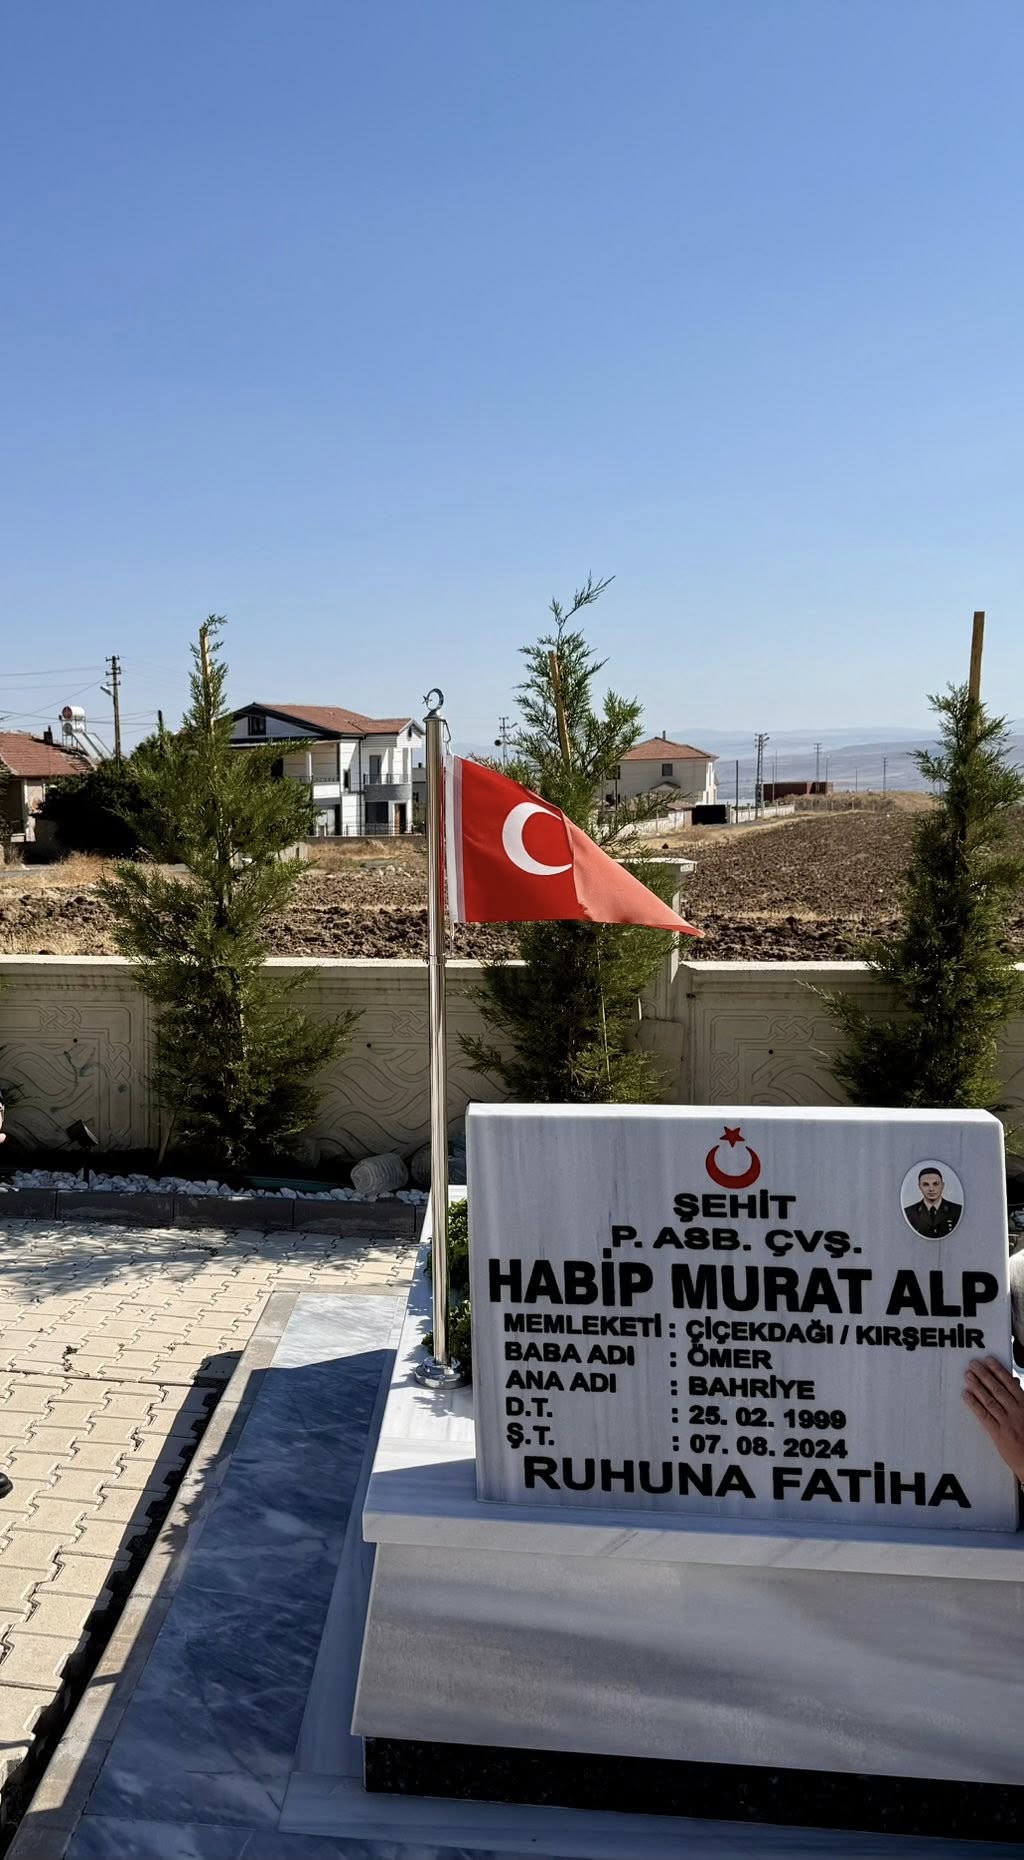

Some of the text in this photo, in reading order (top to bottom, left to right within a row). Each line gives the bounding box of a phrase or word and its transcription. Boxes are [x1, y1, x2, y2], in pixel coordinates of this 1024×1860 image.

[673, 1188, 797, 1223] ŞEHİT
[612, 1224, 862, 1259] P. ASB. ÇVŞ.
[488, 1247, 999, 1318] HABİP MURAT ALP
[503, 1312, 662, 1339] MEMLEKETİ
[685, 1315, 834, 1345] ÇİÇEKDAĞI
[855, 1322, 986, 1352] KIRŞEHİR
[504, 1341, 583, 1364] BABA
[586, 1343, 636, 1367] ADI
[687, 1342, 774, 1370] ÖMER
[505, 1369, 565, 1392] ANA
[569, 1371, 617, 1394] ADI
[688, 1374, 816, 1401] BAHRİYE
[505, 1396, 553, 1418] D.T.
[688, 1404, 728, 1426] 25.
[735, 1406, 775, 1428] 02.
[783, 1408, 847, 1430] 1999
[506, 1421, 555, 1450] Ş.T.
[689, 1433, 729, 1455] 07.
[736, 1435, 776, 1457] 08.
[782, 1437, 849, 1460] 2024
[523, 1455, 973, 1510] RUHUNA FATİHA
